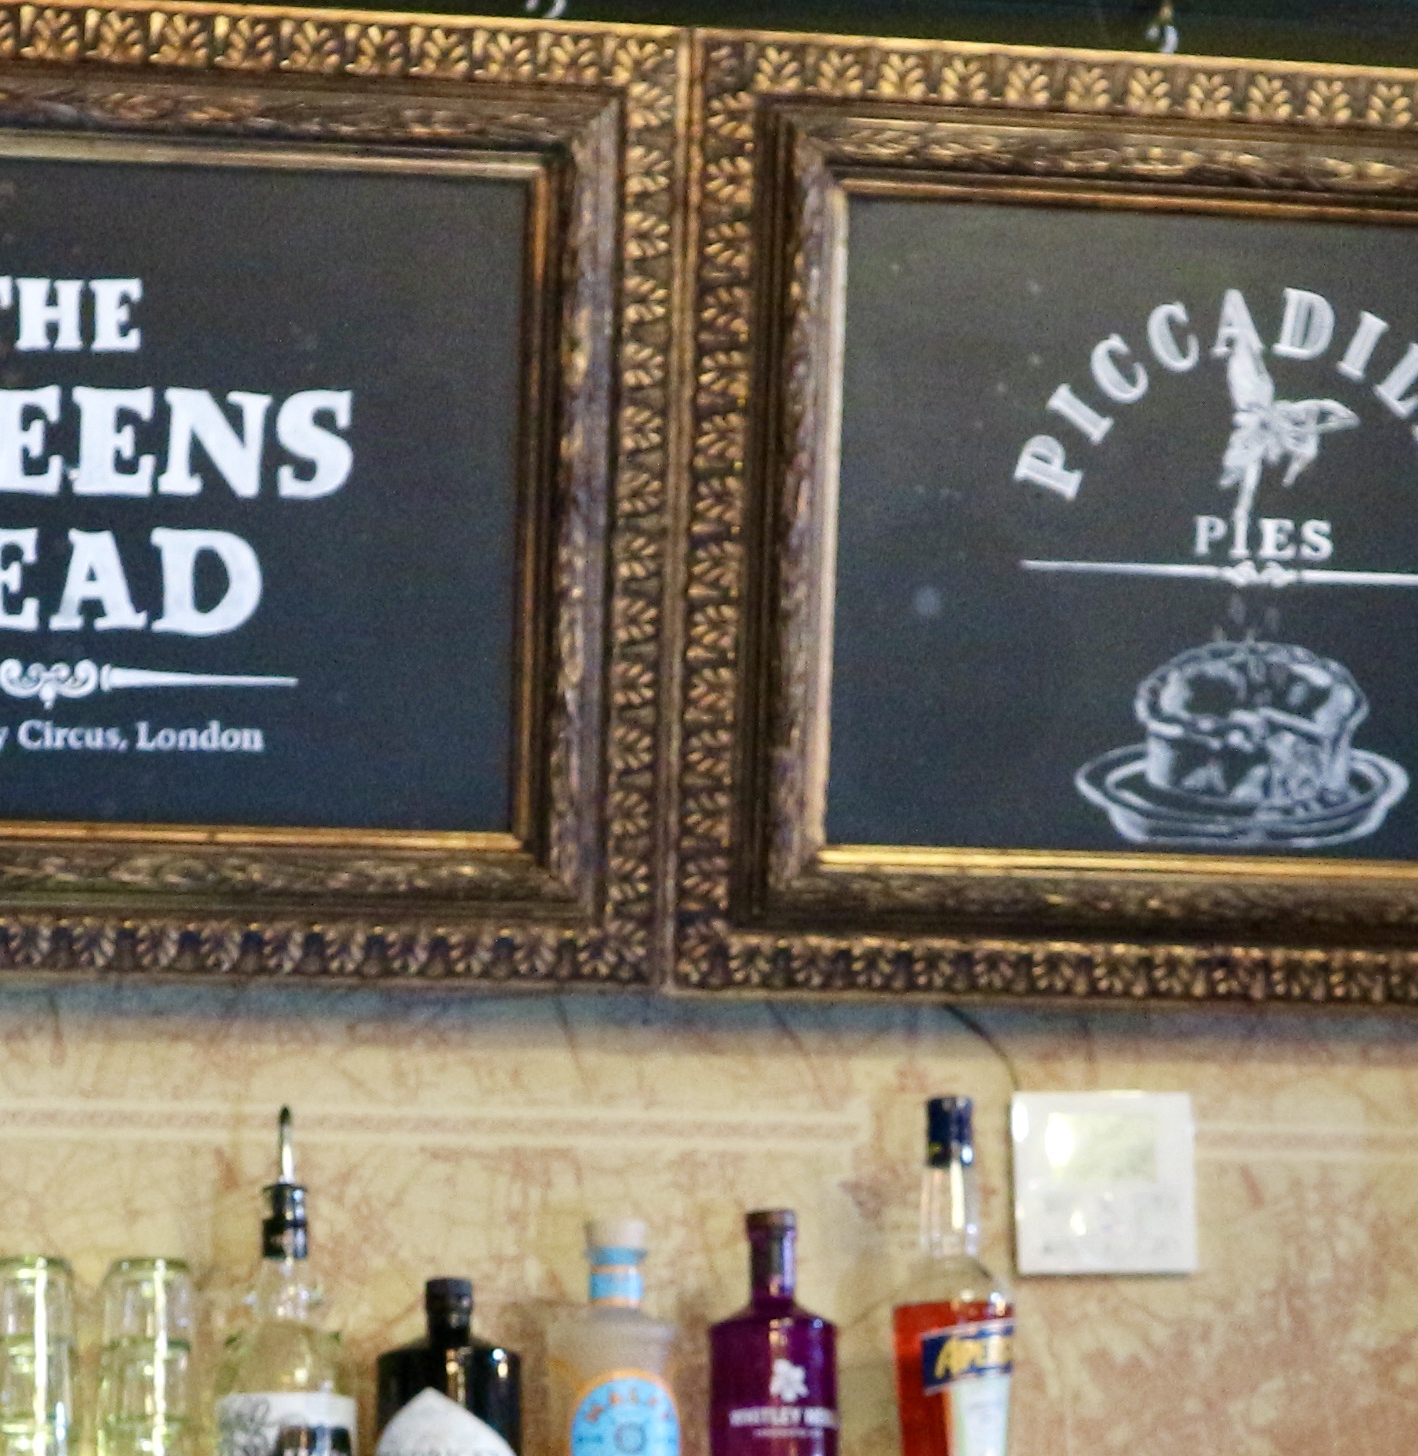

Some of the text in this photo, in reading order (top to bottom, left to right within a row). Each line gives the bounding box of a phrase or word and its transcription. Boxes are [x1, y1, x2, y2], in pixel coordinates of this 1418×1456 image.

[1193, 515, 1334, 562] PIES
[17, 719, 129, 752] Circus,
[135, 720, 265, 753] London
